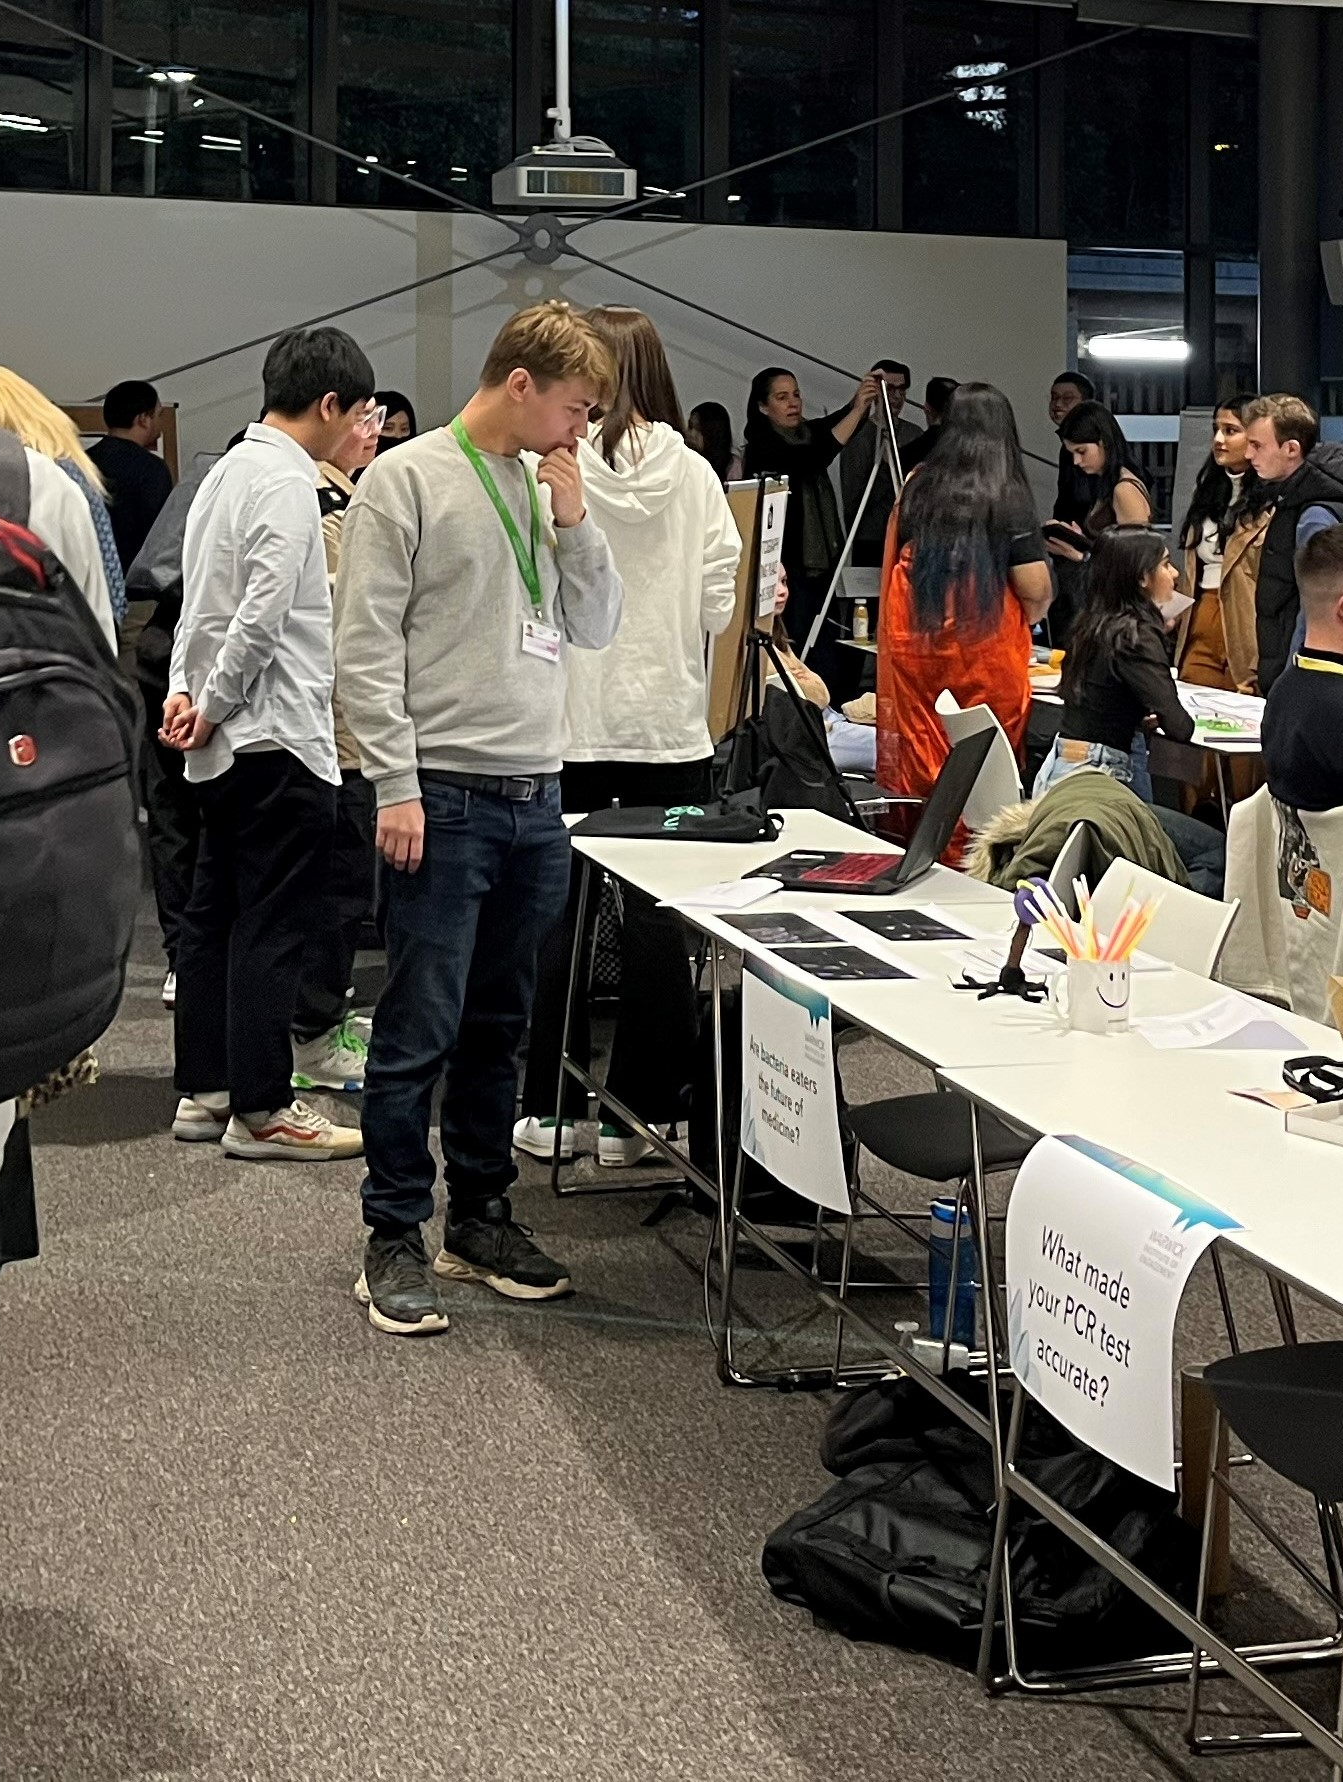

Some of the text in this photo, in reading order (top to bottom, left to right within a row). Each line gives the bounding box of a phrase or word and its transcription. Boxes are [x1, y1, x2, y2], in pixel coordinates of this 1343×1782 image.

[749, 1034, 760, 1058] Are
[760, 1042, 789, 1078] bacteria
[790, 1068, 818, 1095] eaters
[758, 1070, 804, 1117] the future of
[761, 1108, 800, 1146] medicine?
[1041, 1225, 1082, 1279] What
[1083, 1262, 1131, 1309] made
[1027, 1278, 1131, 1368] your PCR test
[1036, 1338, 1110, 1407] accurate?
